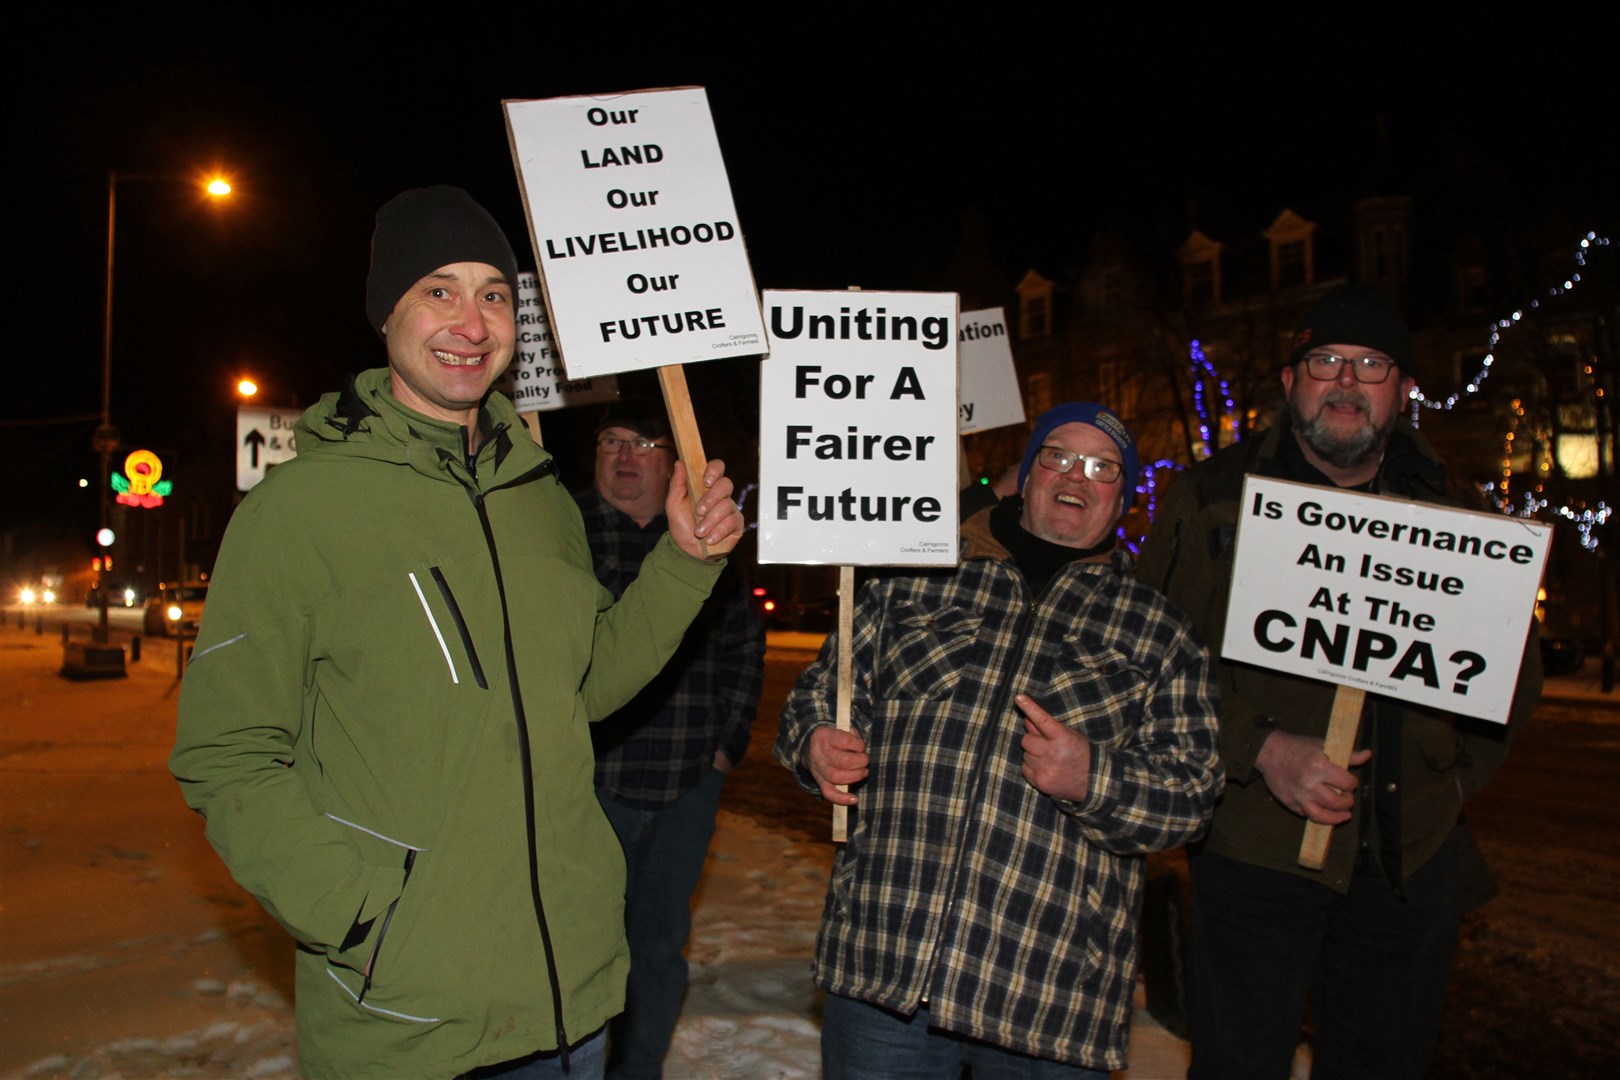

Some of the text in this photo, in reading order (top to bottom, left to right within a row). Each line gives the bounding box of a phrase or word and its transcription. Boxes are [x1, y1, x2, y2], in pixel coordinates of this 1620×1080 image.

[587, 108, 640, 126] Our
[580, 144, 664, 169] LAND
[606, 188, 659, 209] Our
[546, 221, 734, 260] LIVELIHOOD
[626, 273, 680, 294] Our
[600, 308, 726, 342] FUTURE
[771, 306, 949, 350] Uniting
[510, 370, 530, 381] To
[556, 380, 592, 394] Food
[795, 366, 926, 400] For A
[786, 425, 935, 461] Fairer
[777, 486, 942, 522] Future
[1252, 492, 1534, 565] Is Governance
[1296, 544, 1465, 596] An Issue
[1308, 587, 1436, 632] At The
[1253, 609, 1487, 696] CNPA?
